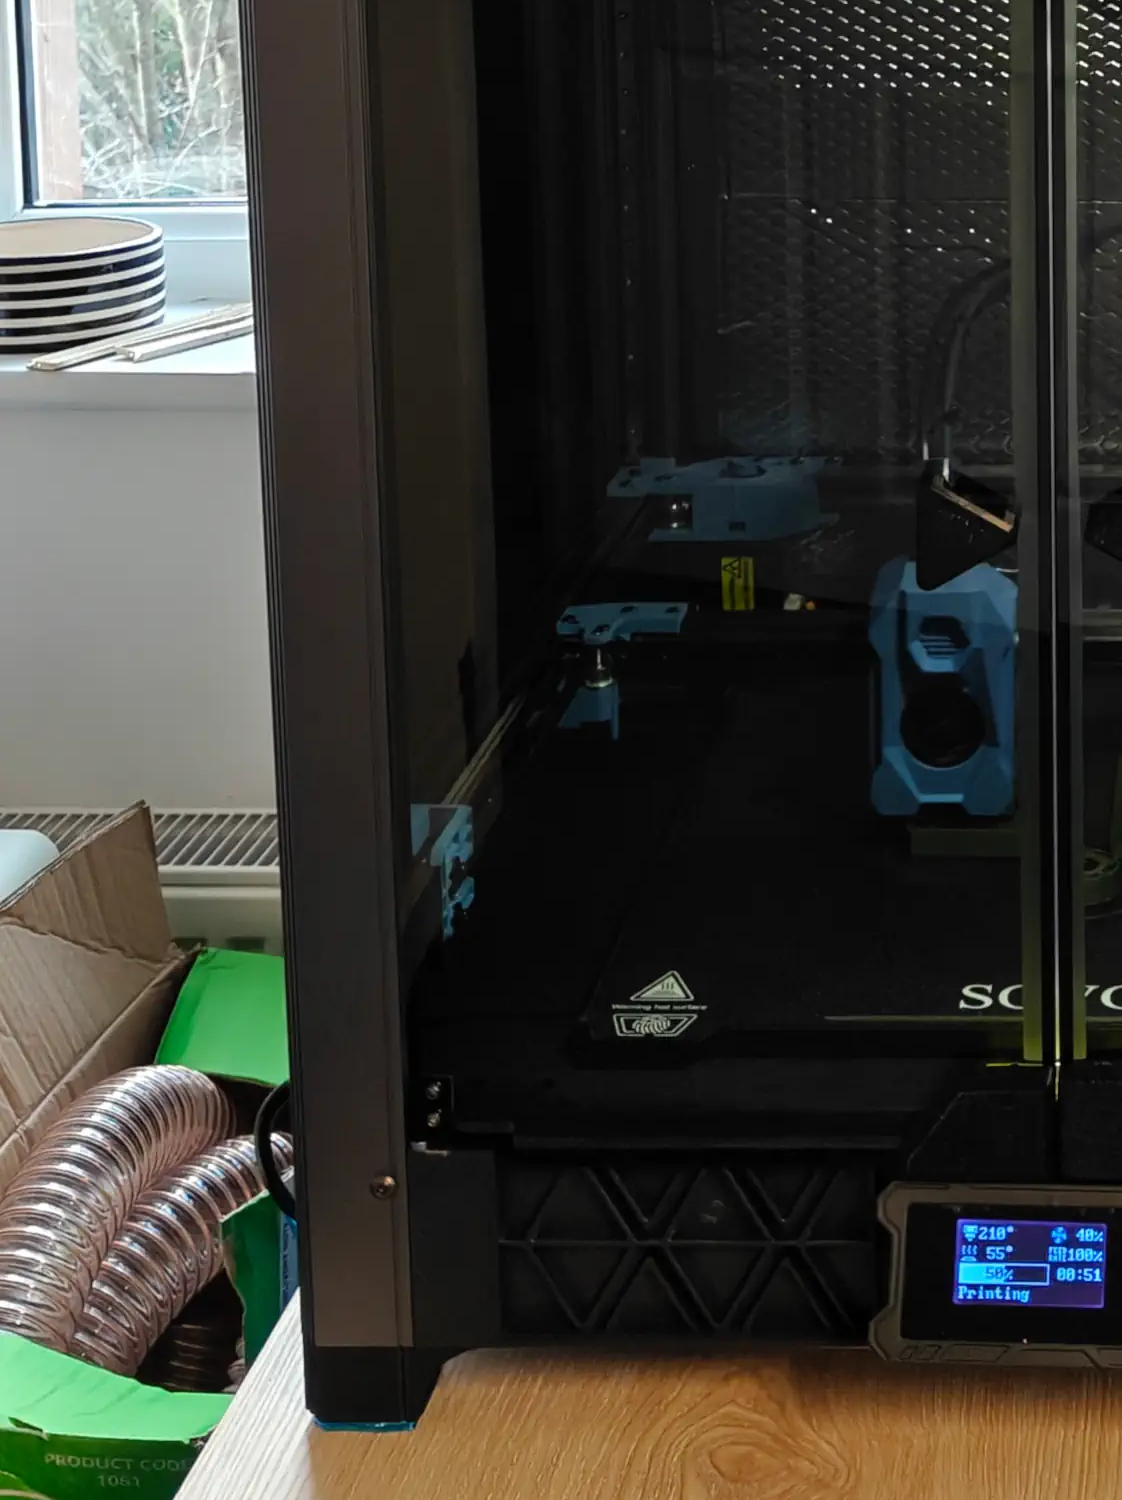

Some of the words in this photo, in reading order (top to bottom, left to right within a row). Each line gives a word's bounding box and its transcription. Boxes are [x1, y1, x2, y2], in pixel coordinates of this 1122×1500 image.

[1075, 1228, 1103, 1242] 40%
[1068, 1248, 1103, 1262] 100%
[984, 1266, 1014, 1280] 50%
[1056, 1267, 1102, 1282] 00:51
[958, 1285, 1030, 1303] Printing
[44, 1453, 134, 1471] PRODUCT
